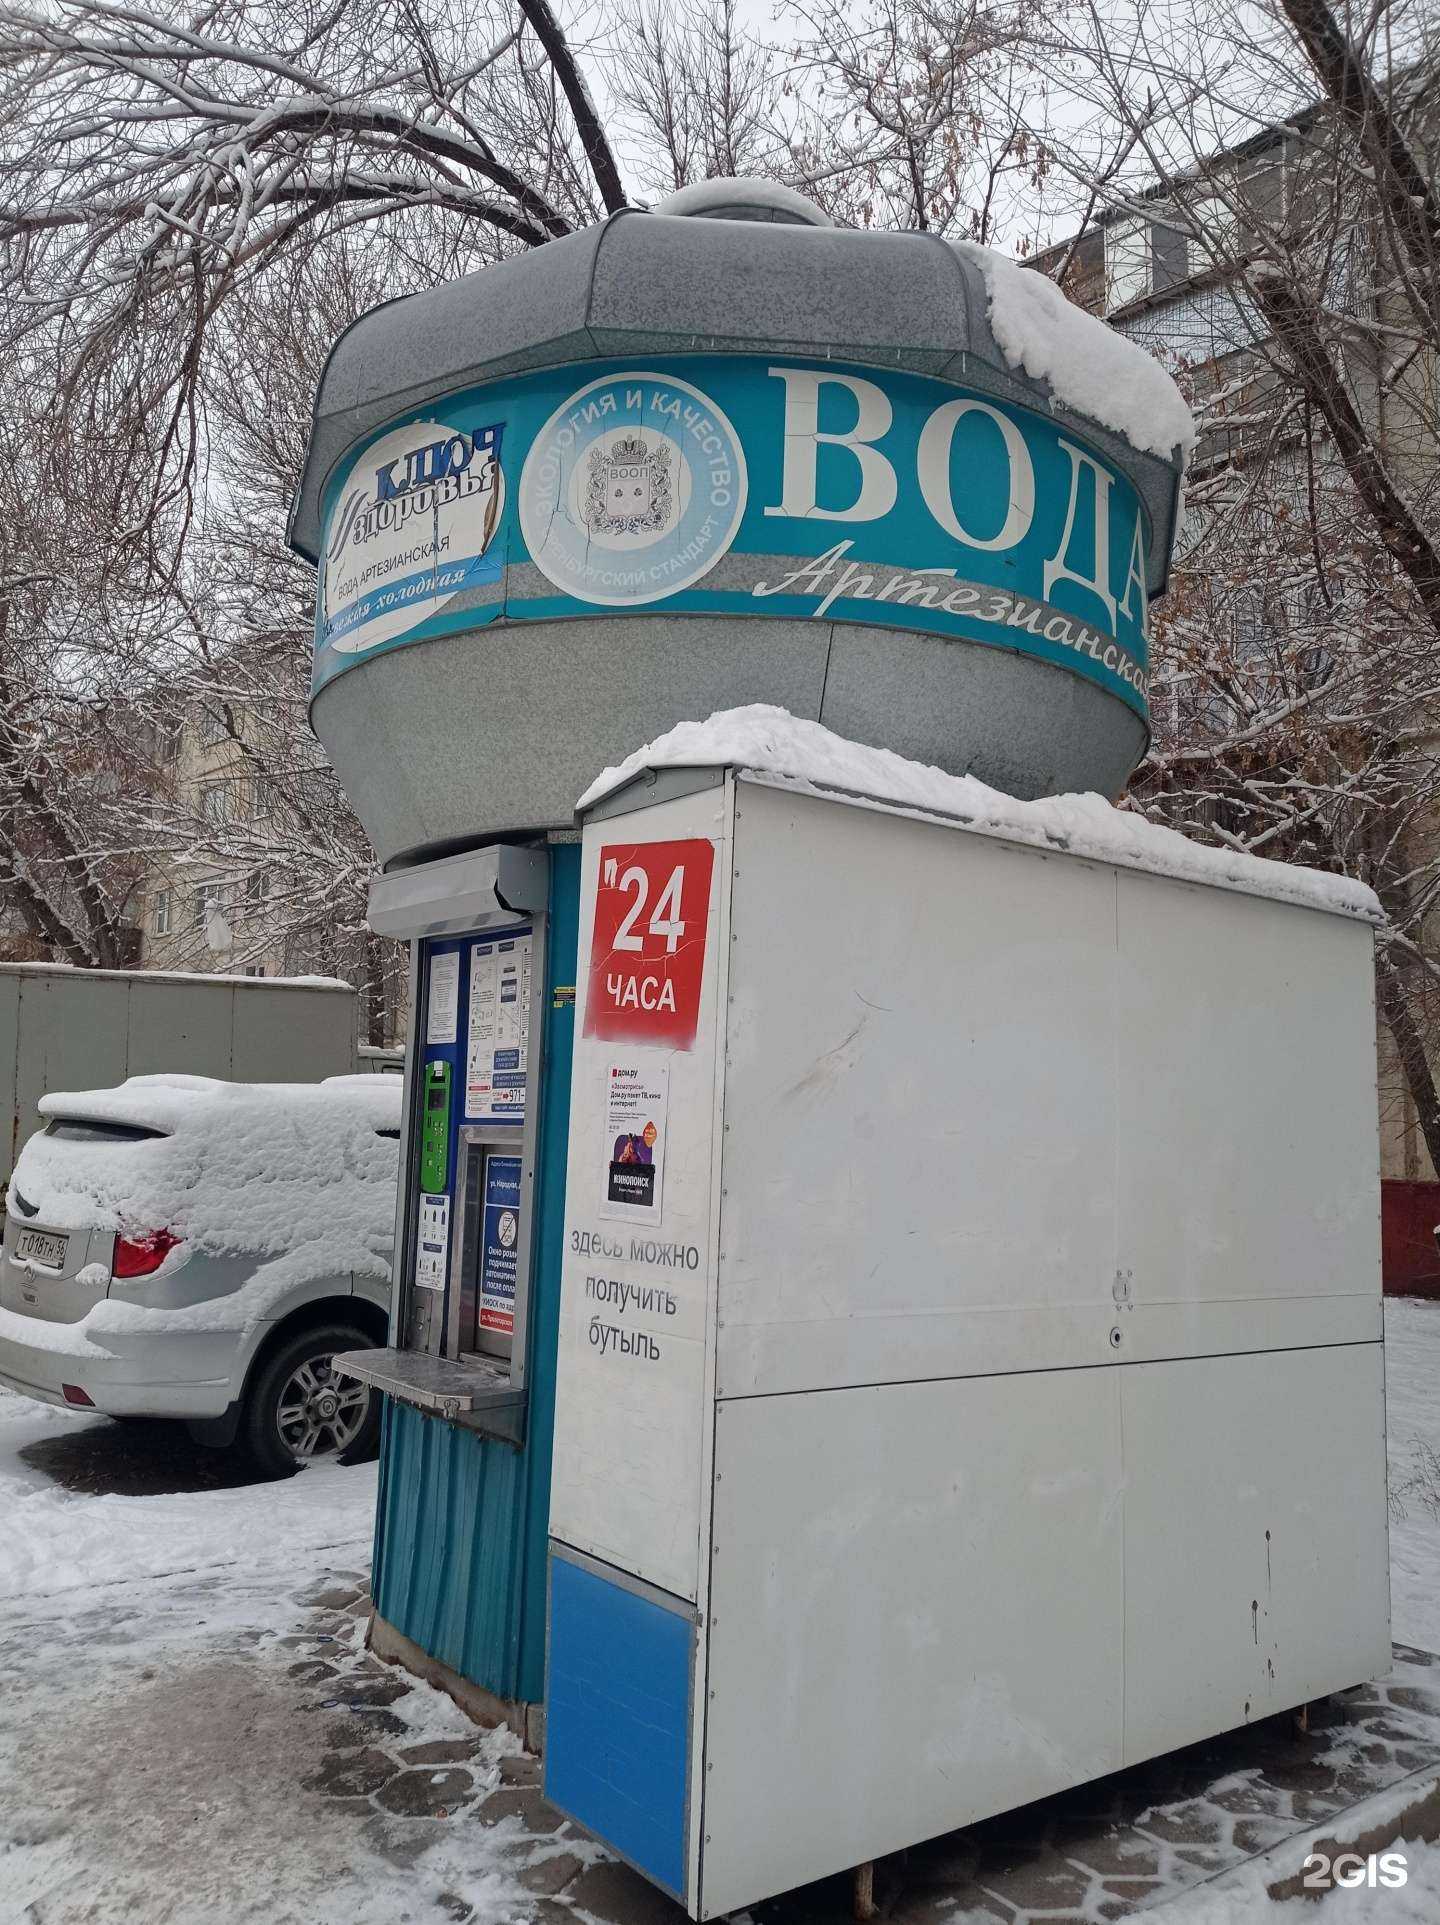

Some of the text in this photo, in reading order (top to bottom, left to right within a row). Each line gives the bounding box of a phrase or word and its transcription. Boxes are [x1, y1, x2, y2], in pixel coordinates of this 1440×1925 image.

[375, 421, 506, 501] КЛЮЧ
[536, 389, 731, 517] ЭКОЛОГИЯ И КАЧЕСТВО
[610, 467, 649, 480] ВООП
[764, 367, 1149, 642] ВОДА
[338, 535, 450, 600] ВОДА АРТЕЗИАНСКАЯ
[650, 515, 719, 581] СТАНДАРТ
[374, 568, 466, 610] холодная
[751, 539, 1149, 700] Артезианска
[611, 865, 685, 953] 24
[607, 973, 676, 1012] ЧАСА
[571, 1230, 699, 1270] здесь можно
[586, 1276, 677, 1315] получить
[588, 1315, 660, 1360] бутыль
